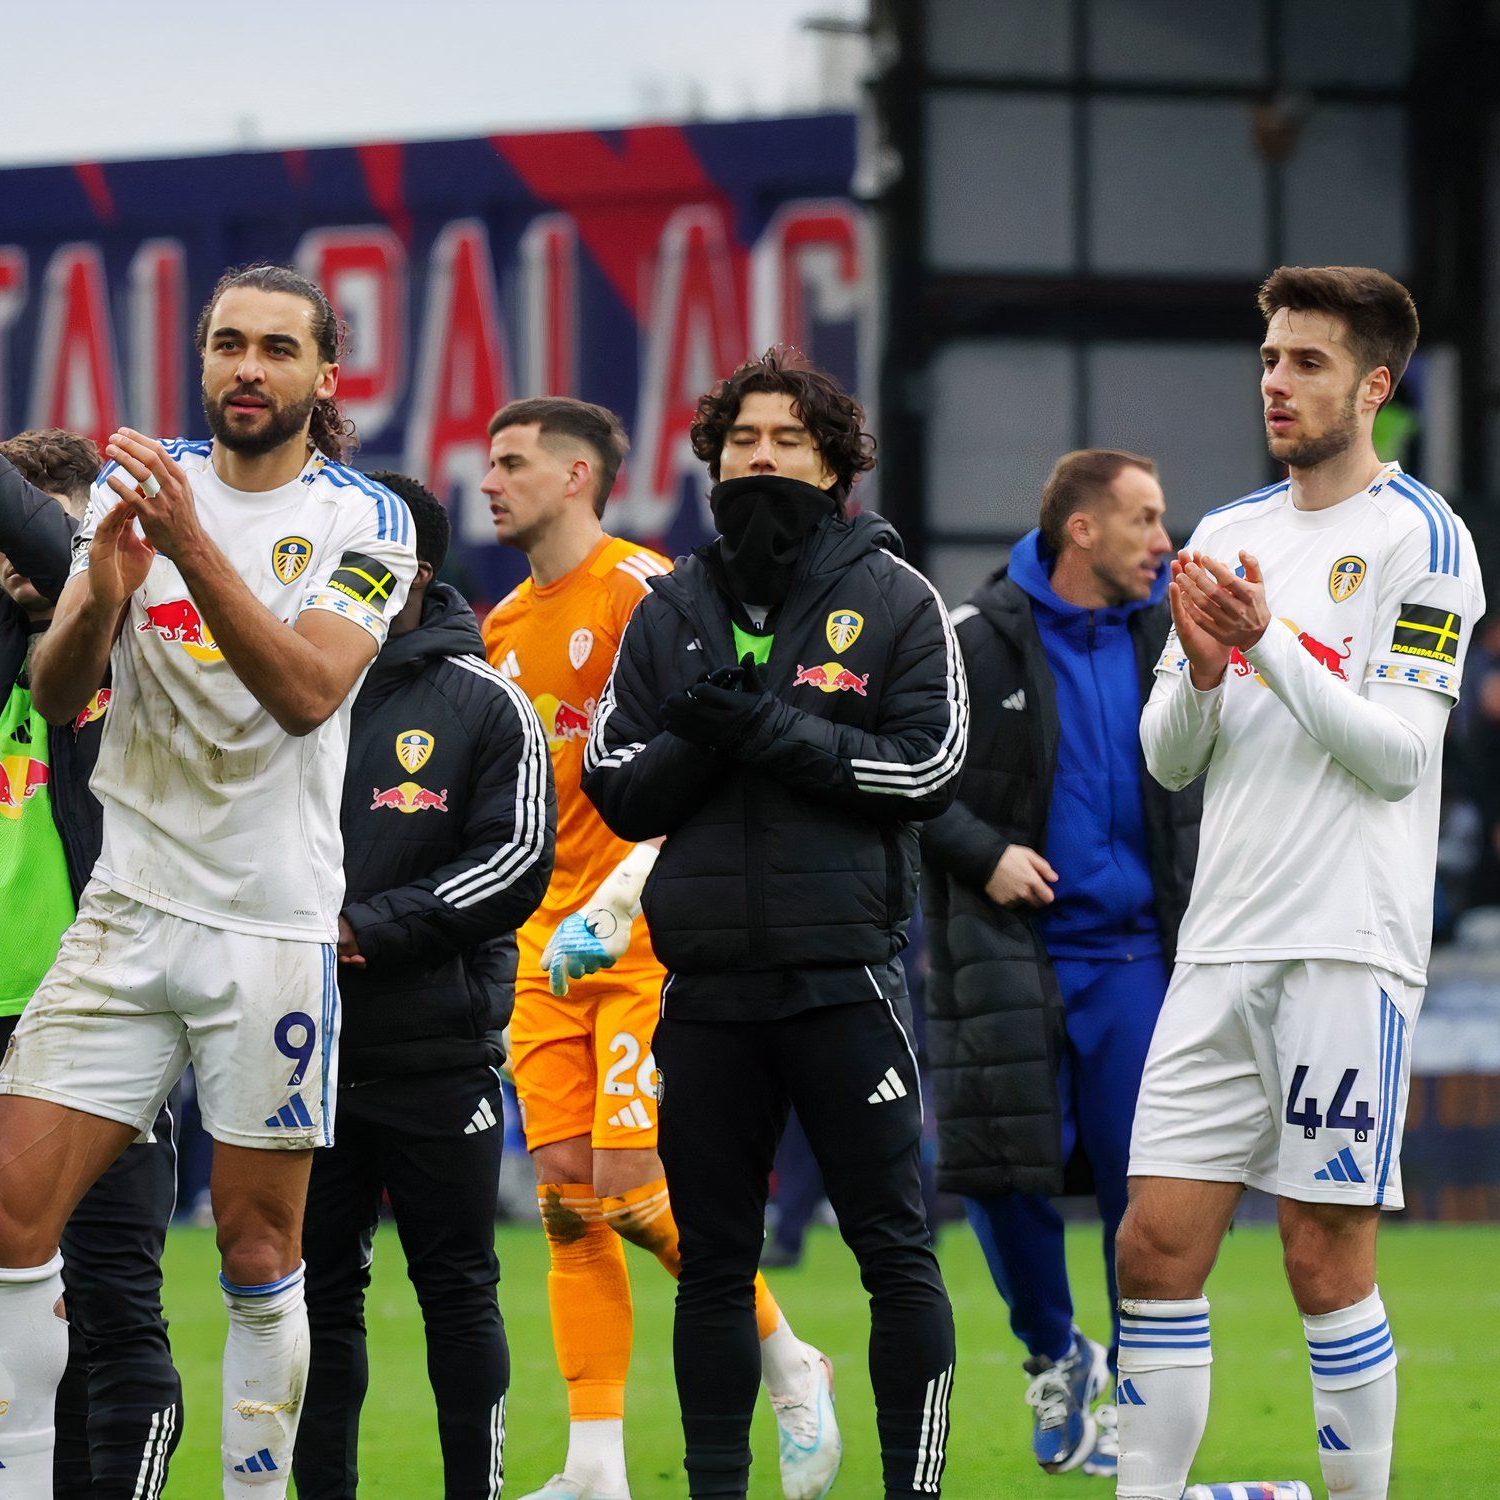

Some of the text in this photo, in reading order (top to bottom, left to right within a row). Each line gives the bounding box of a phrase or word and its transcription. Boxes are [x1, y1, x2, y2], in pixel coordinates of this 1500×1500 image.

[274, 1011, 316, 1086] 9
[604, 1031, 658, 1099] 26
[1286, 1064, 1375, 1142] 44
